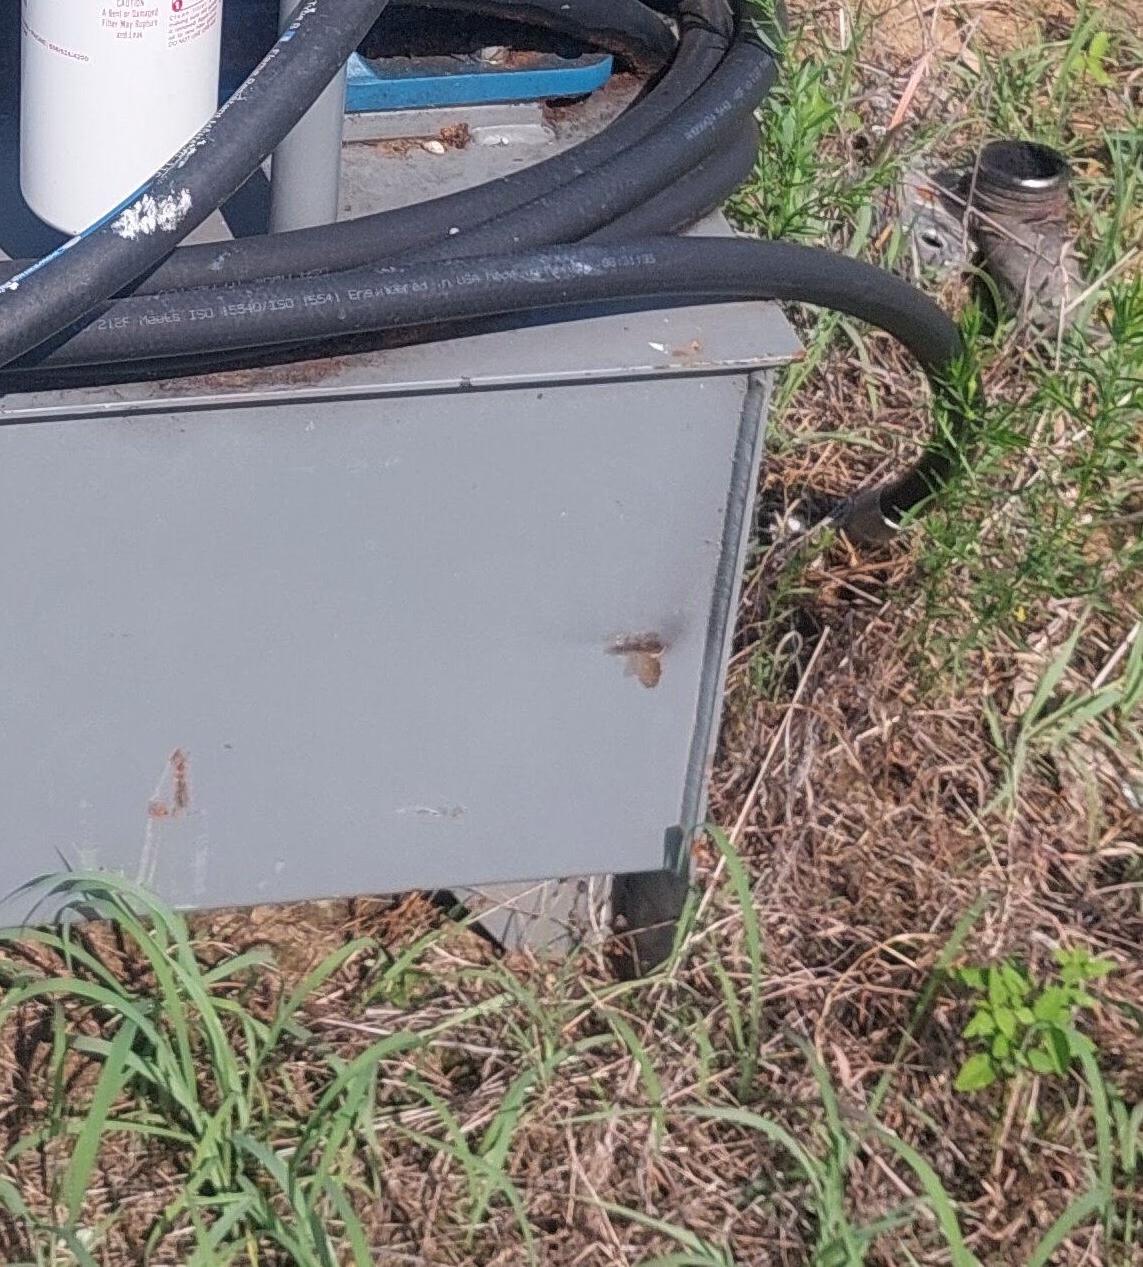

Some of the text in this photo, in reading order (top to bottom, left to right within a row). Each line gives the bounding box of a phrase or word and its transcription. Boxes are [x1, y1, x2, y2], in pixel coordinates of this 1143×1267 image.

[101, 8, 107, 17] A
[101, 18, 118, 27] Filter
[119, 19, 133, 29] May
[188, 308, 215, 321] ISO
[302, 291, 341, 308] 15541
[456, 273, 482, 286] USA
